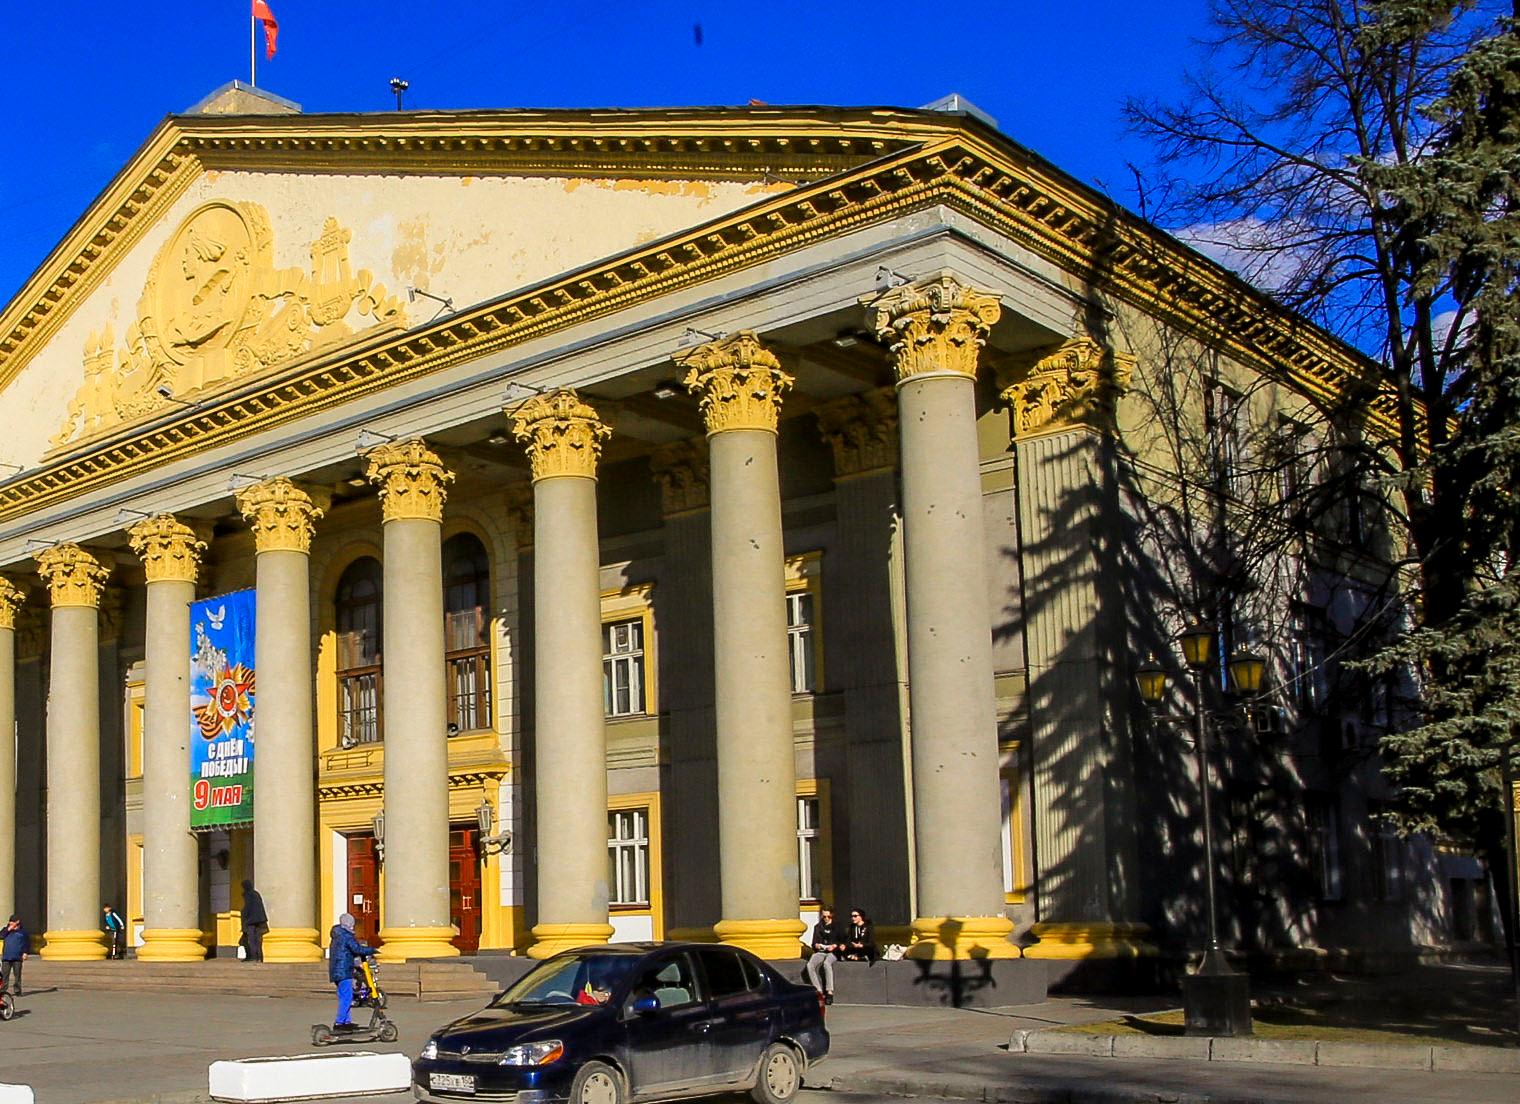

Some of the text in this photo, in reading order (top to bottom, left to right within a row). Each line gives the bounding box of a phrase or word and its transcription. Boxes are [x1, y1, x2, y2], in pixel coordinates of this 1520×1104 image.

[208, 743, 216, 759] С
[201, 757, 248, 778] ПОБЕДЫ!
[194, 779, 242, 810] 9 МАЯ
